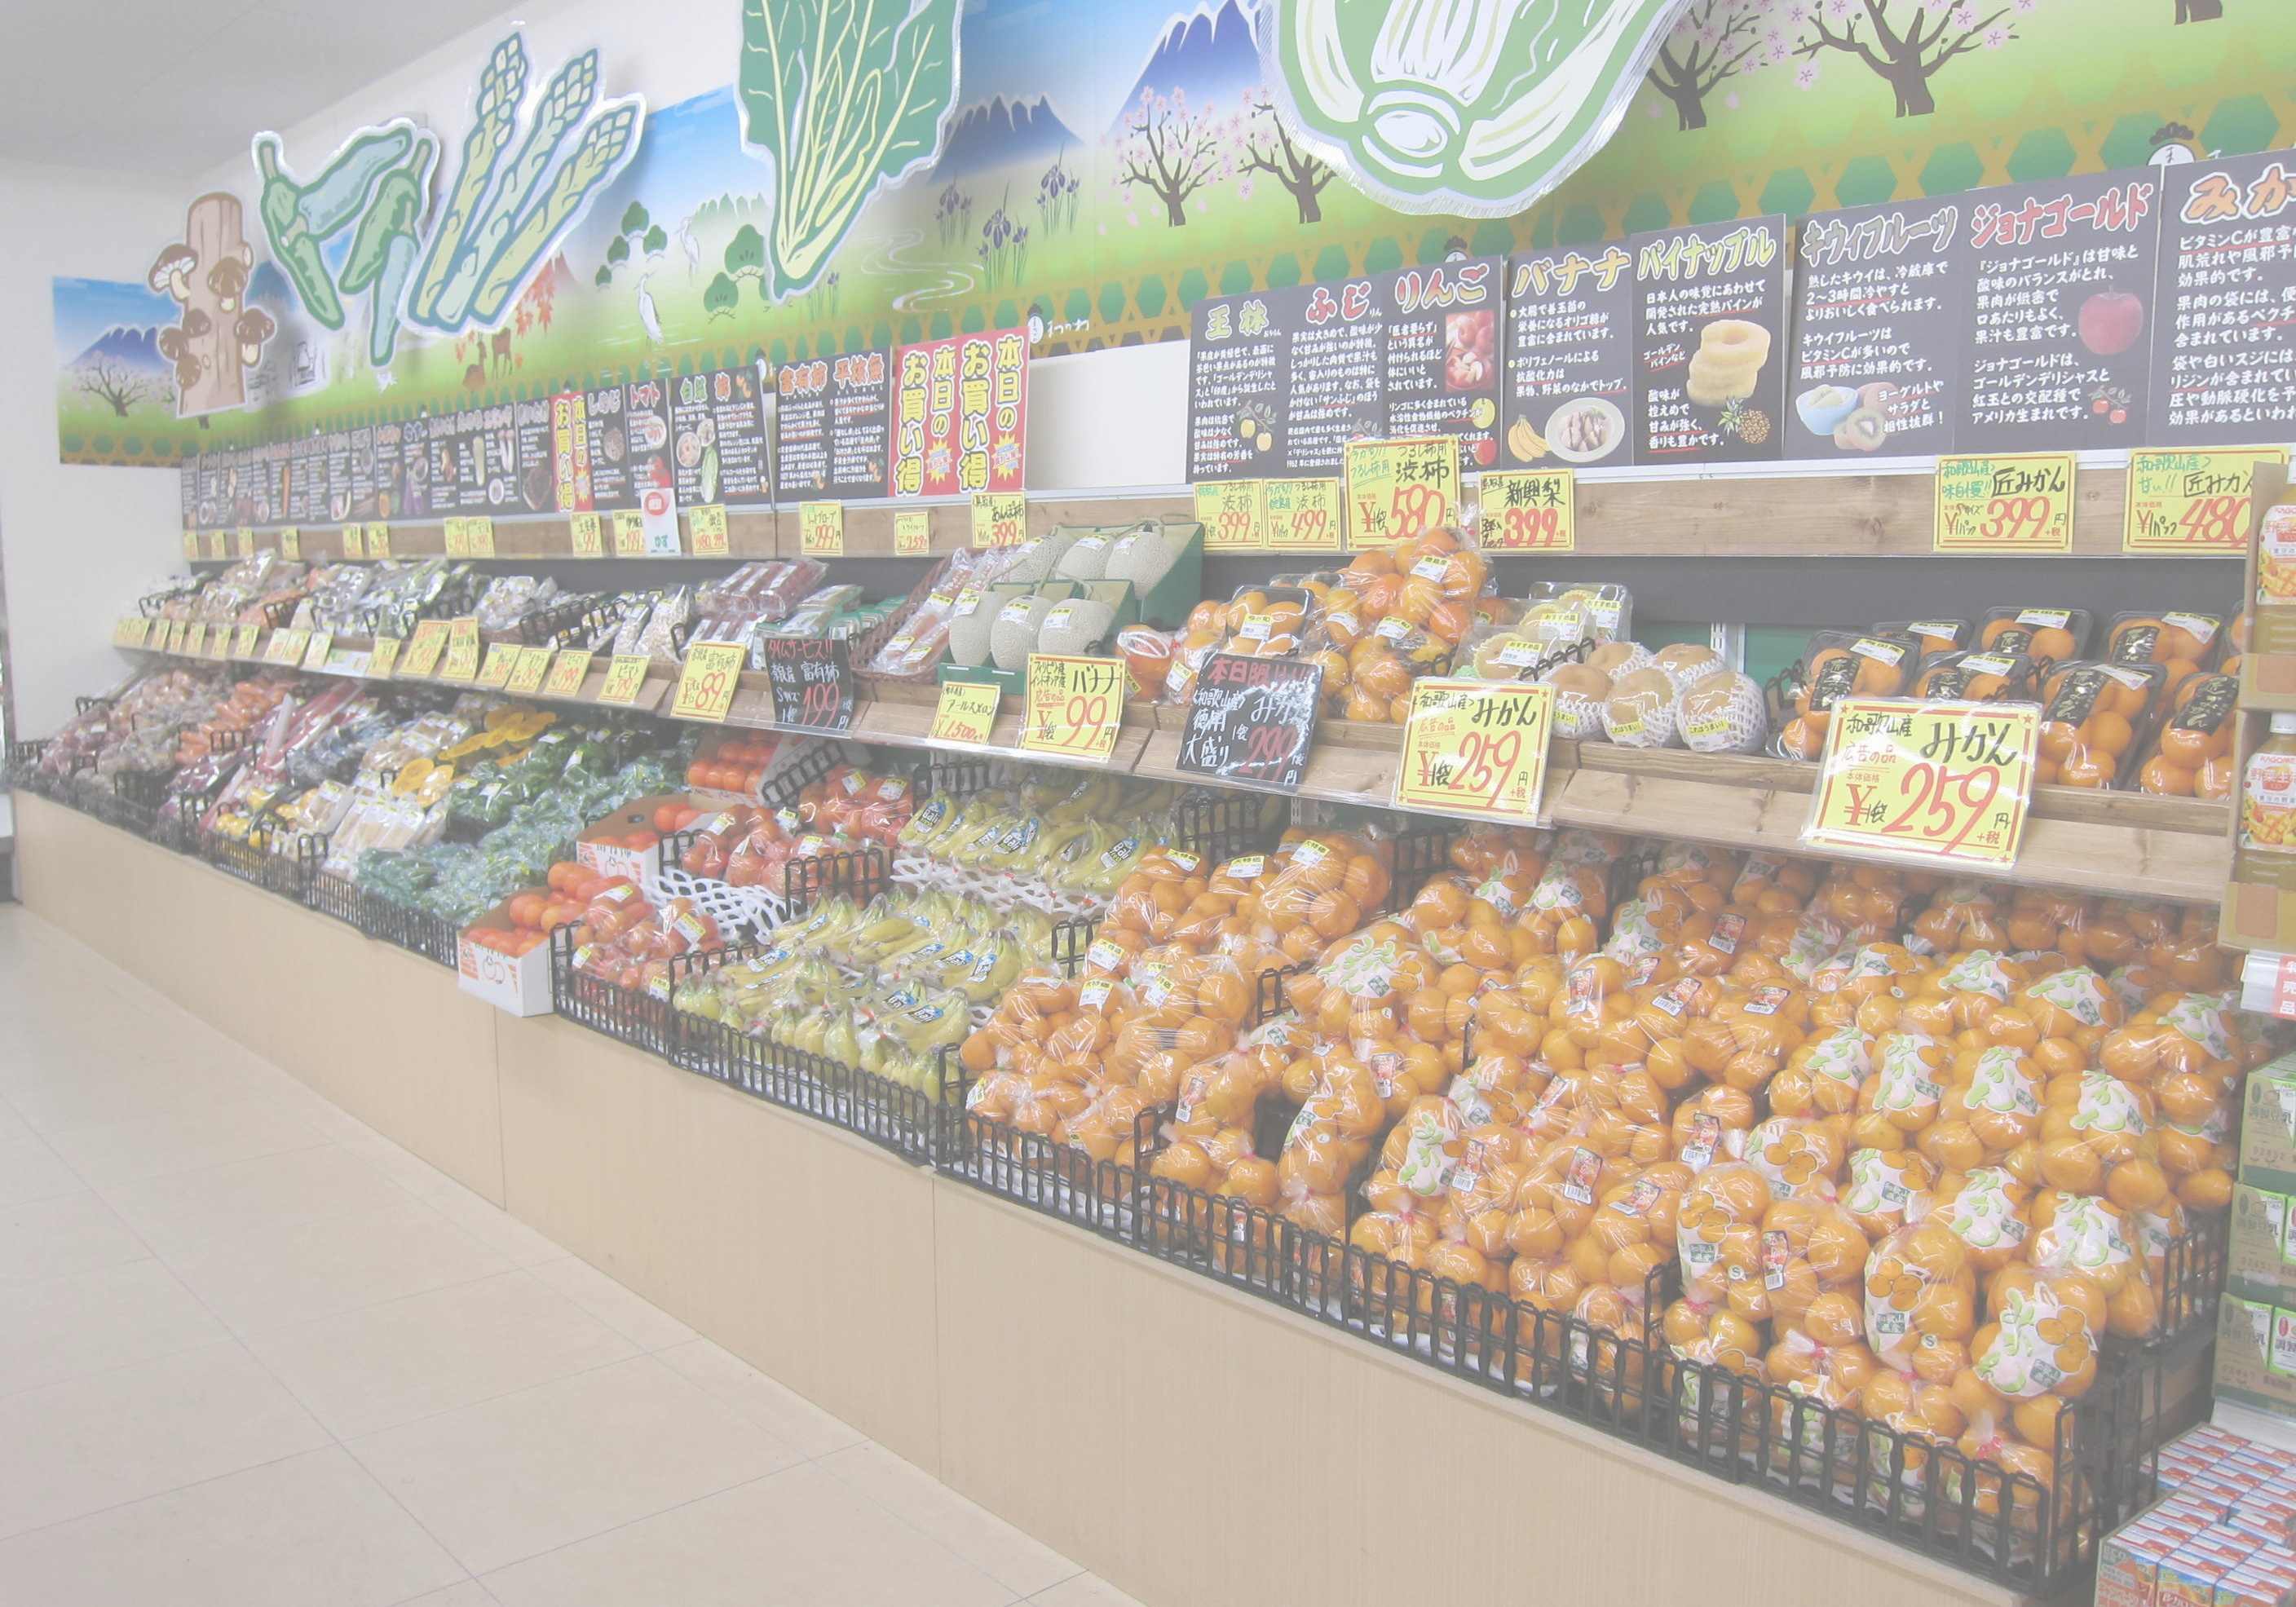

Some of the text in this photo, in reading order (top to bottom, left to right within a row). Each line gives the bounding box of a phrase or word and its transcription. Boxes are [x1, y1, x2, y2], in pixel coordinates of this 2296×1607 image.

[1971, 183, 2152, 248] ジョナゴールド
[1637, 226, 1776, 281] パイナップル
[1978, 245, 2139, 275] 『ジョナゴールド』は甘味と
[1512, 246, 1631, 297] バナナ
[1807, 261, 1948, 289] 熟したキウイは、冷蔵庫で
[1976, 267, 2114, 294] 酸味のバランスがとれ、
[2177, 267, 2263, 288] 効果的です。
[1395, 263, 1490, 314] りんご
[1646, 280, 1766, 305] 日本人の味覚にあわせて
[2176, 286, 2296, 311] 果肉の袋には、便
[1306, 280, 1373, 324] ふじ
[1517, 300, 1586, 319] 大腸で善玉菌の
[1645, 296, 1762, 320] 開発された完熟パインが
[1804, 297, 1942, 322] よりおいしく食べられます。
[1976, 289, 2059, 310] 果肉が緻密で
[1205, 299, 1269, 340] 王林
[1517, 312, 1609, 333] 栄養になるオリゴ糖が
[1645, 320, 1693, 335] 人気です。
[1976, 307, 2064, 327] 口あたりもよく、
[1292, 323, 1383, 343] 果実は大きめで、酸味が少
[1388, 322, 1437, 337] 「医者要らず」
[1517, 329, 1614, 348] 豊富に含まれています。
[1803, 326, 1892, 347] キウイフルーツは
[1975, 323, 2077, 345] 果汁も豊富です。
[2174, 325, 2283, 348] 含まれています。
[1292, 339, 1376, 355] なく甘みが強いのが特徴。
[1388, 337, 1433, 350] という異名が
[1644, 342, 1680, 360] ゴールデン
[1801, 342, 1910, 364] ビタミンCが多いので
[1291, 351, 1377, 369] しっかりした肉質で果汁も
[1388, 349, 1442, 364] 付けられるほど
[1516, 350, 1599, 368] ポリフェノールによる
[1649, 352, 1685, 369] パインなど
[1974, 353, 2079, 373] ジョナゴールドは、
[779, 360, 828, 395] 富有柿
[1291, 365, 1375, 382] 多く、蜜入りのものは特に
[1388, 364, 1426, 377] 体にいいと
[1516, 369, 1564, 382] 抗酸化力は
[1800, 359, 1932, 381] 風邪予防に効果的です。
[1972, 367, 2109, 391] ゴールデンデリシャスと
[932, 346, 956, 436] 本日の
[996, 333, 1025, 430] 本日の
[1290, 377, 1380, 395] 人気があります。なお、袋を
[1388, 377, 1437, 391] されています。
[1516, 377, 1627, 398] 果物、野菜のなかでトップ。
[1879, 378, 1944, 402] ヨーグルトや
[630, 382, 660, 409] トマト
[1194, 396, 1241, 408] いわれています。
[1289, 391, 1378, 408] かけない「サンふじ」のほう
[1389, 397, 1467, 411] リンゴに多く含まれている
[1648, 388, 1680, 403] 酸味が
[1972, 386, 2081, 408] 紅玉との交配種で
[2169, 386, 2296, 408] 圧や動脈硬化を予
[960, 338, 991, 494] お買い得
[1288, 408, 1352, 421] が甘みは強めです。
[1888, 397, 1930, 416] サラダと
[1971, 404, 2089, 426] アメリカ生まれです。
[572, 395, 587, 467] 本日の
[895, 350, 929, 497] お買い得
[1194, 426, 1231, 438] 酸味は少なく
[1648, 418, 1702, 433] 甘みが強く、
[1883, 410, 1944, 434] 相性抜群！
[1397, 440, 1446, 457] つるし柿用
[1648, 433, 1724, 449] 香りも豊かです。
[555, 399, 575, 513] お買い得
[1396, 457, 1450, 489] 渋柿
[1991, 466, 2065, 497] 匠みかん
[991, 501, 1024, 522] あんぽ柿
[1222, 492, 1253, 513] 渋柿
[1296, 492, 1326, 513] 渋柿
[1386, 483, 1446, 540] 580
[2135, 501, 2163, 509] 本体価格
[1217, 511, 1251, 541] 399
[1291, 510, 1327, 541] 499
[1503, 508, 1558, 547] 399
[1980, 497, 2050, 539] 399
[907, 535, 925, 550] 259
[991, 520, 1018, 546] 399
[1544, 613, 1575, 622] おすすめ品
[768, 639, 833, 660] タイムサービス!!
[1509, 641, 1540, 650] おすすめ品
[706, 651, 736, 673] 富有柿
[801, 660, 839, 684] 富有柿
[1072, 665, 1121, 695] バナナ
[695, 672, 726, 712] 89
[1035, 689, 1065, 703] 広告の品
[802, 682, 839, 727] 199
[947, 698, 995, 715] アールスメロン
[1472, 695, 1536, 727] みかん
[1062, 695, 1107, 750] 99
[1193, 709, 1227, 738] 徳用
[1418, 717, 1456, 732] 広告の品
[1846, 712, 1914, 737] 和歌山産
[1183, 733, 1230, 767] 大盛り
[1842, 741, 1897, 764] 広告の品
[1919, 722, 2018, 766] みかん
[1238, 726, 1299, 784] 299
[1448, 731, 1521, 808] 259
[1846, 772, 1880, 783] 本体価格
[923, 809, 940, 824] Bali
[1881, 762, 2011, 854] 259 円
[1003, 837, 1020, 850] Bali
[1976, 831, 2000, 844] +税
[1112, 841, 1134, 859] Bali
[1170, 850, 1199, 863] 大特価
[1235, 856, 1262, 865] 大特価
[1732, 1267, 1739, 1277] S
[1926, 1336, 1936, 1346] S
